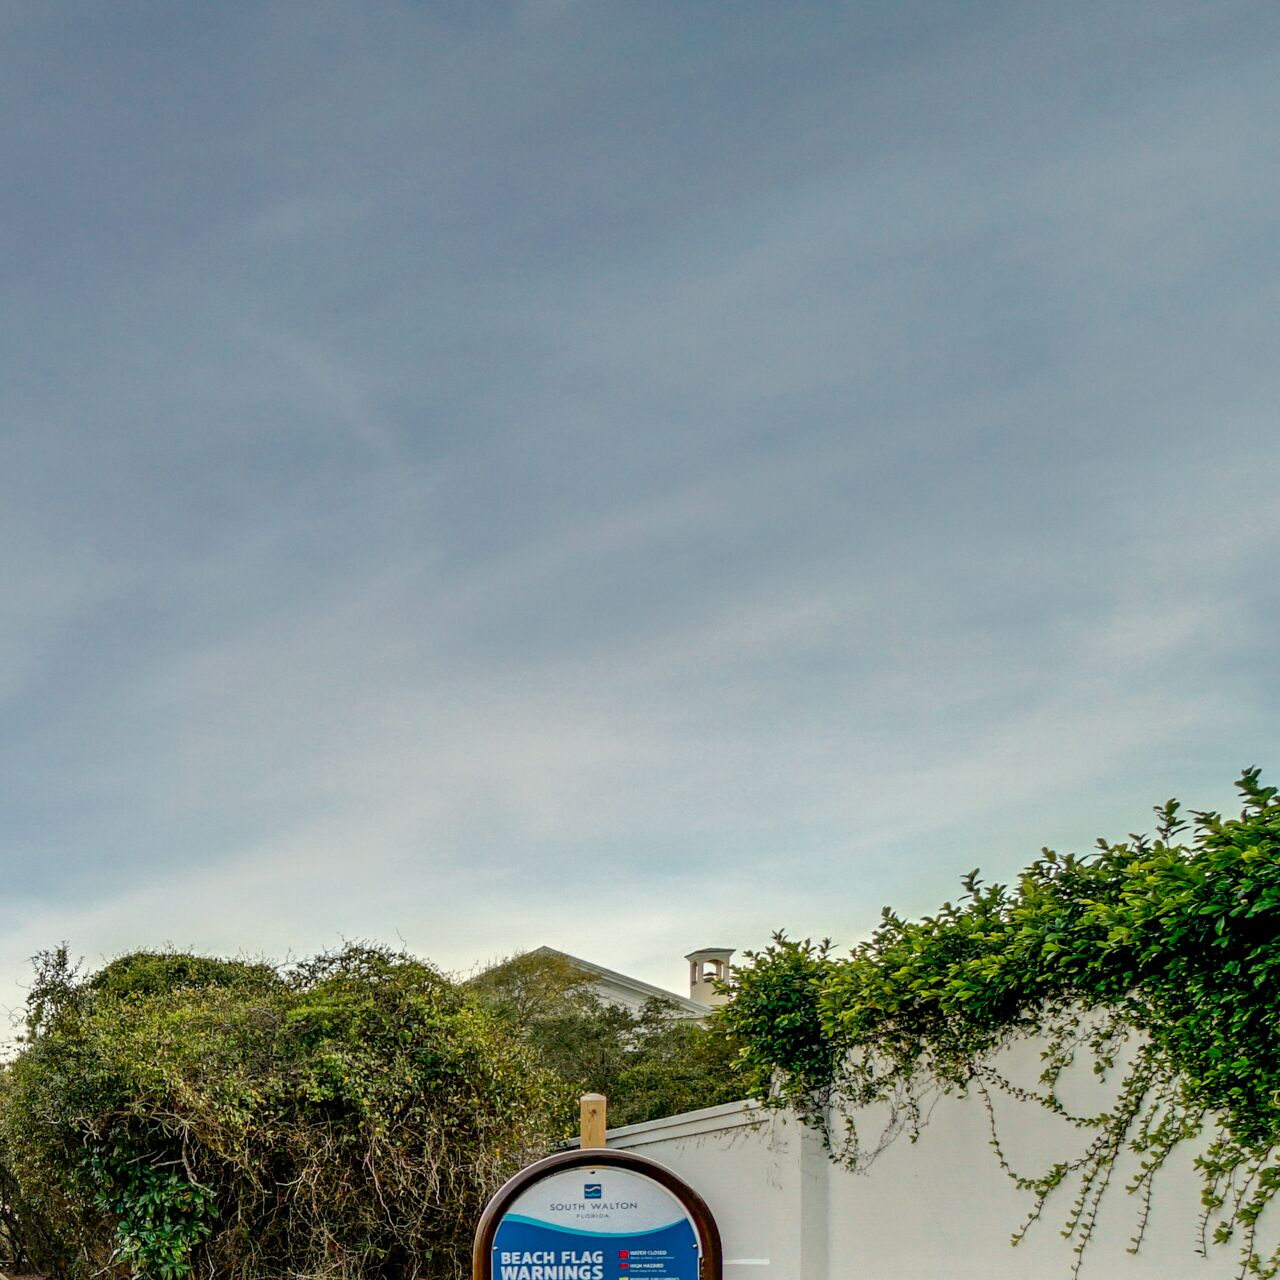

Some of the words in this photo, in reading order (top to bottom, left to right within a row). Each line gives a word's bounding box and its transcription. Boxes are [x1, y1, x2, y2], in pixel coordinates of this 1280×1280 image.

[501, 1252, 557, 1264] BEACH
[562, 1251, 603, 1264] FLAG
[501, 1266, 604, 1280] WARNINGS
